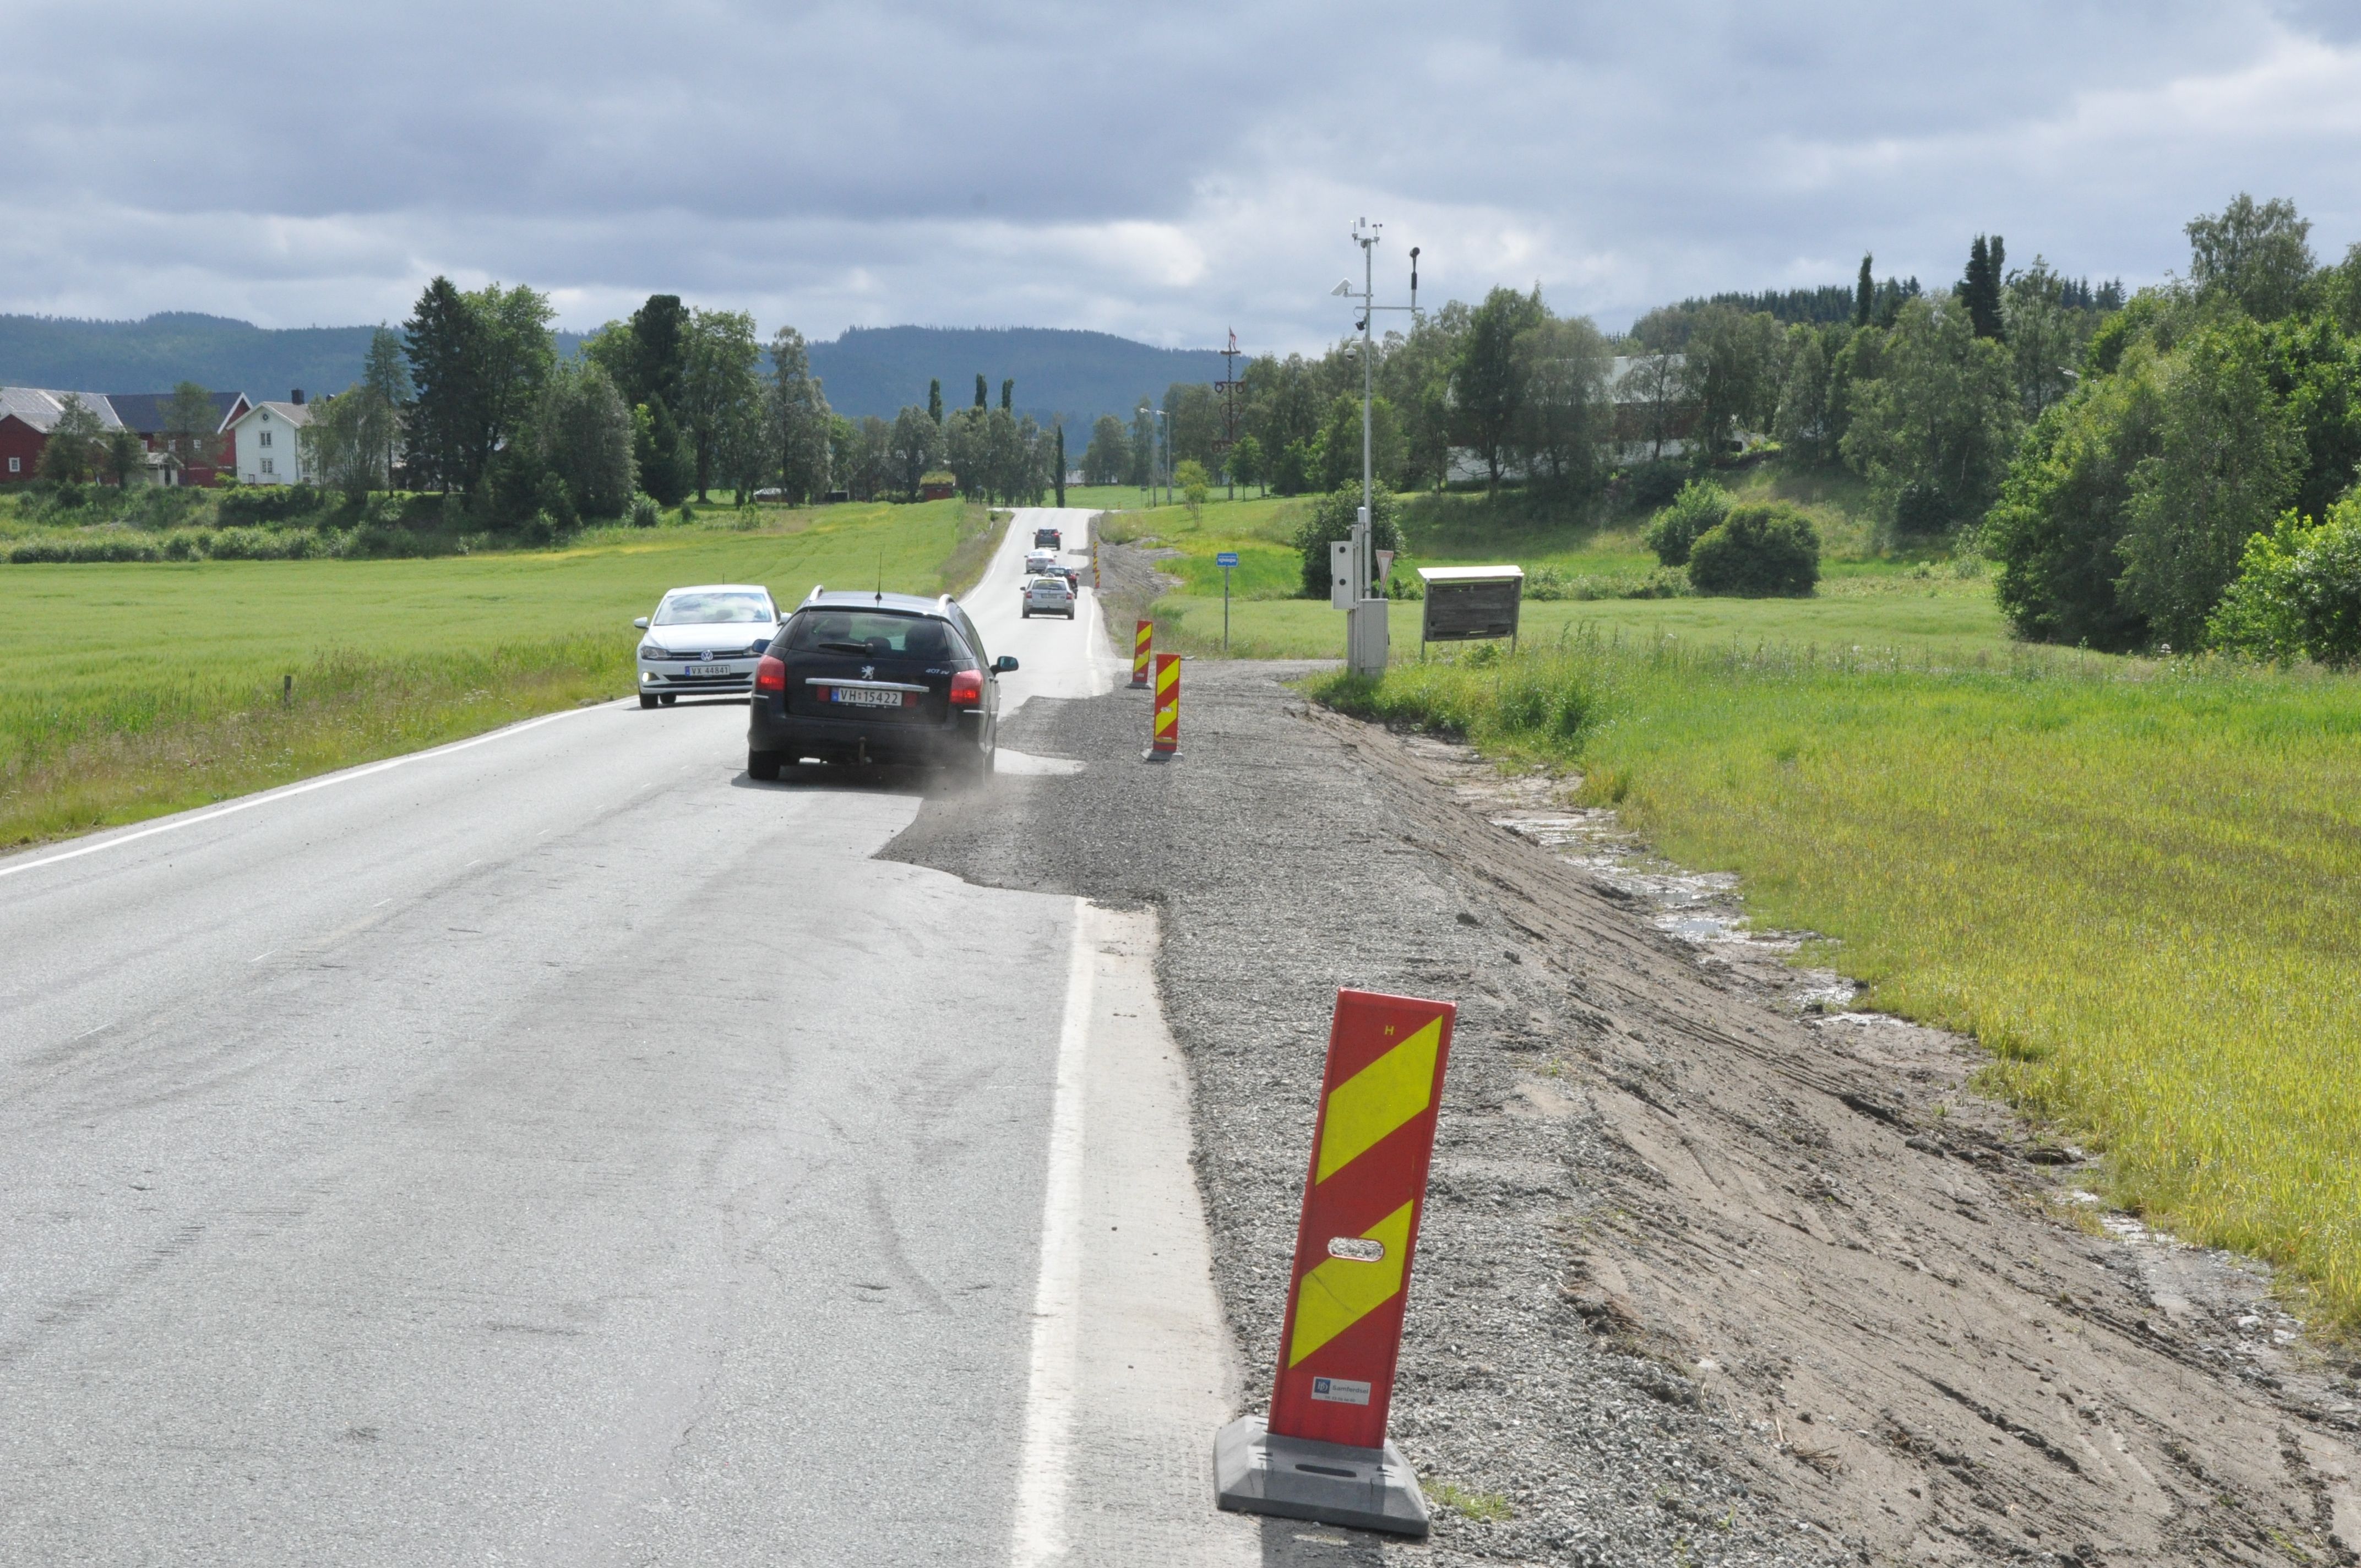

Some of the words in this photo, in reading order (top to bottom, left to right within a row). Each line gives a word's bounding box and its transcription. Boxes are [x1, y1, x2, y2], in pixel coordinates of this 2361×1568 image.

[841, 689, 856, 701] VH
[863, 691, 898, 704] 15422
[1385, 1025, 1394, 1036] H
[1332, 1385, 1369, 1394] Samferdsel
